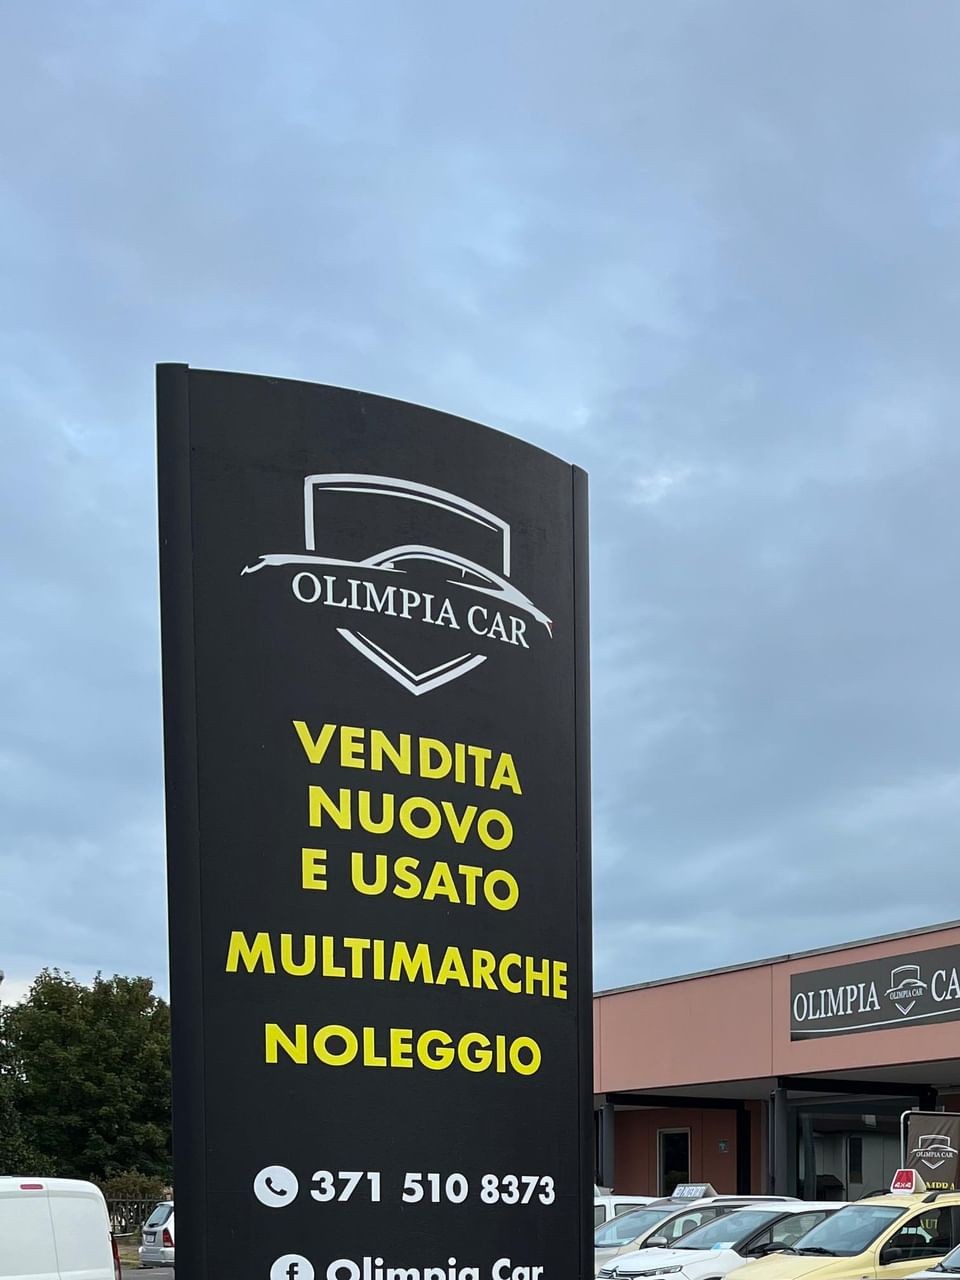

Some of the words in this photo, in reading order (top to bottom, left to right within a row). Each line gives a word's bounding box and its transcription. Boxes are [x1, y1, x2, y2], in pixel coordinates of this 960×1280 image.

[292, 572, 461, 630] OLIMPIA
[468, 605, 530, 649] CAR
[292, 720, 523, 796] VENDITA
[308, 785, 514, 851] NUOVO
[302, 847, 328, 891] E
[351, 852, 520, 911] USATO
[225, 931, 568, 1000] MULTIMARCHE
[911, 987, 924, 999] CAR
[793, 981, 881, 1022] OLIMPIA
[265, 1023, 542, 1076] NOLEGGIO
[310, 1170, 382, 1202] 371
[402, 1172, 469, 1203] 510
[480, 1174, 556, 1205] 8373
